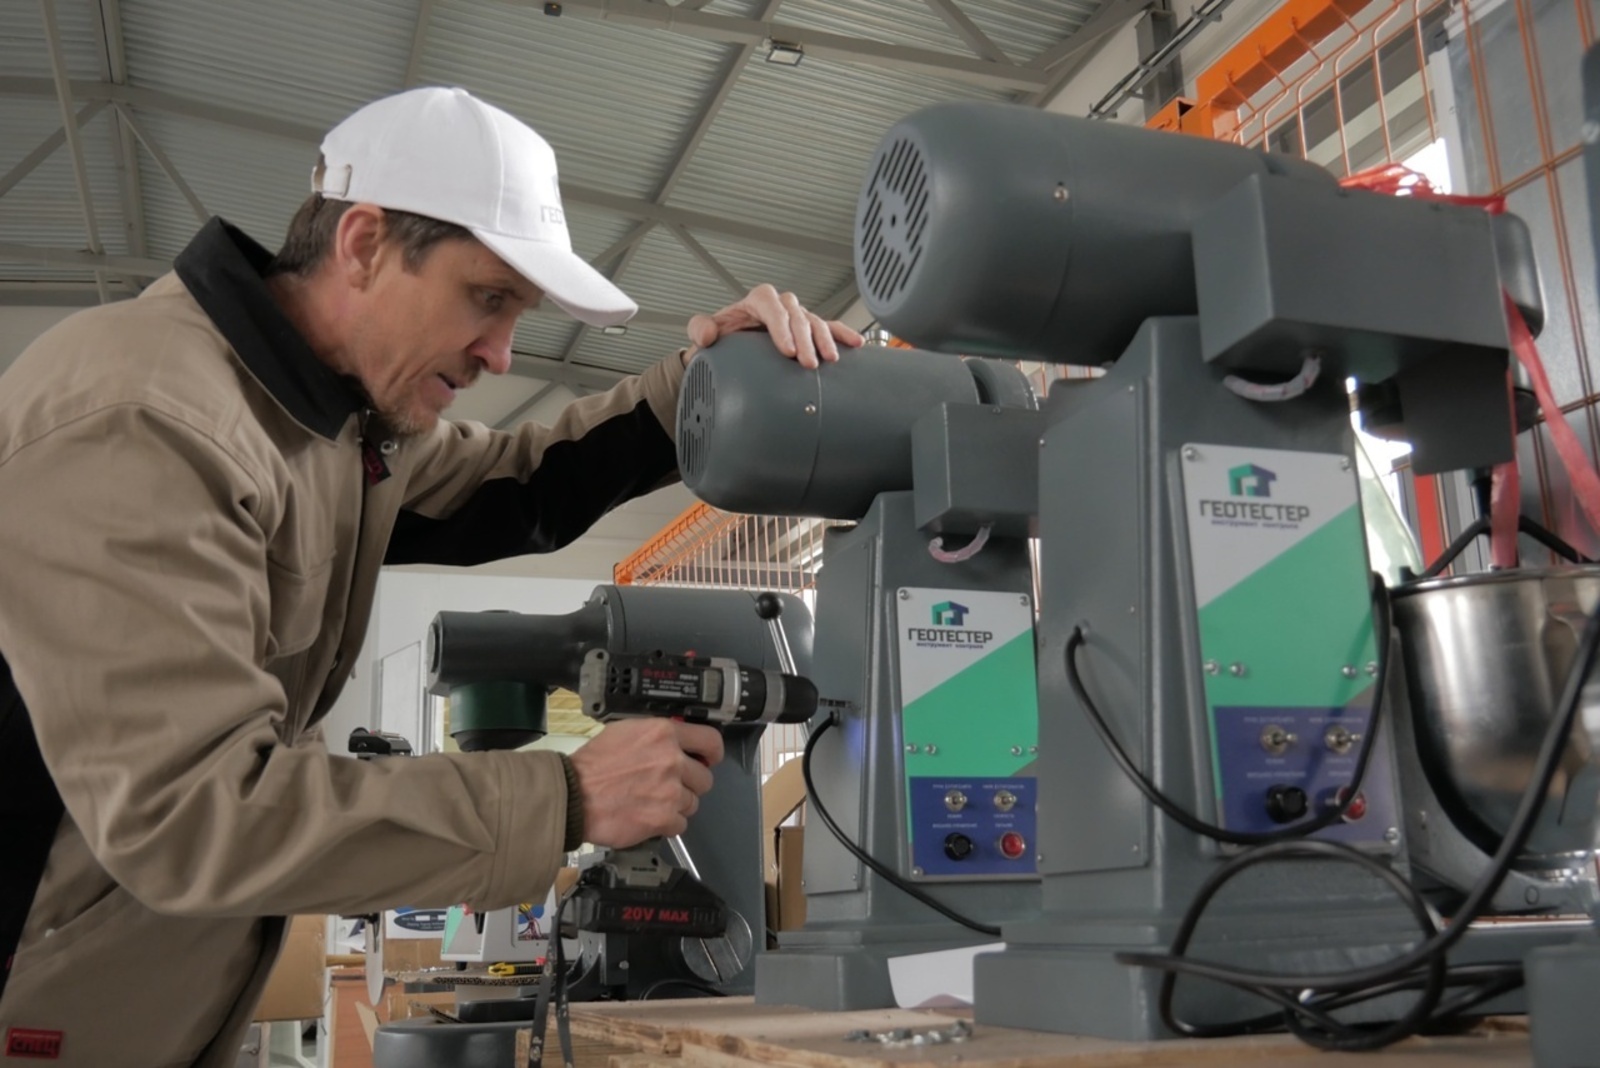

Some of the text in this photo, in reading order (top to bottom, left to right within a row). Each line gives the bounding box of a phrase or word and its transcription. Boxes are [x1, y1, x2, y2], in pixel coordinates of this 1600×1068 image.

[1199, 500, 1310, 522] ГЕОТЕСТЕР
[908, 628, 993, 644] ГЕОТЕСТЕР
[622, 905, 689, 923] 20V MAX
